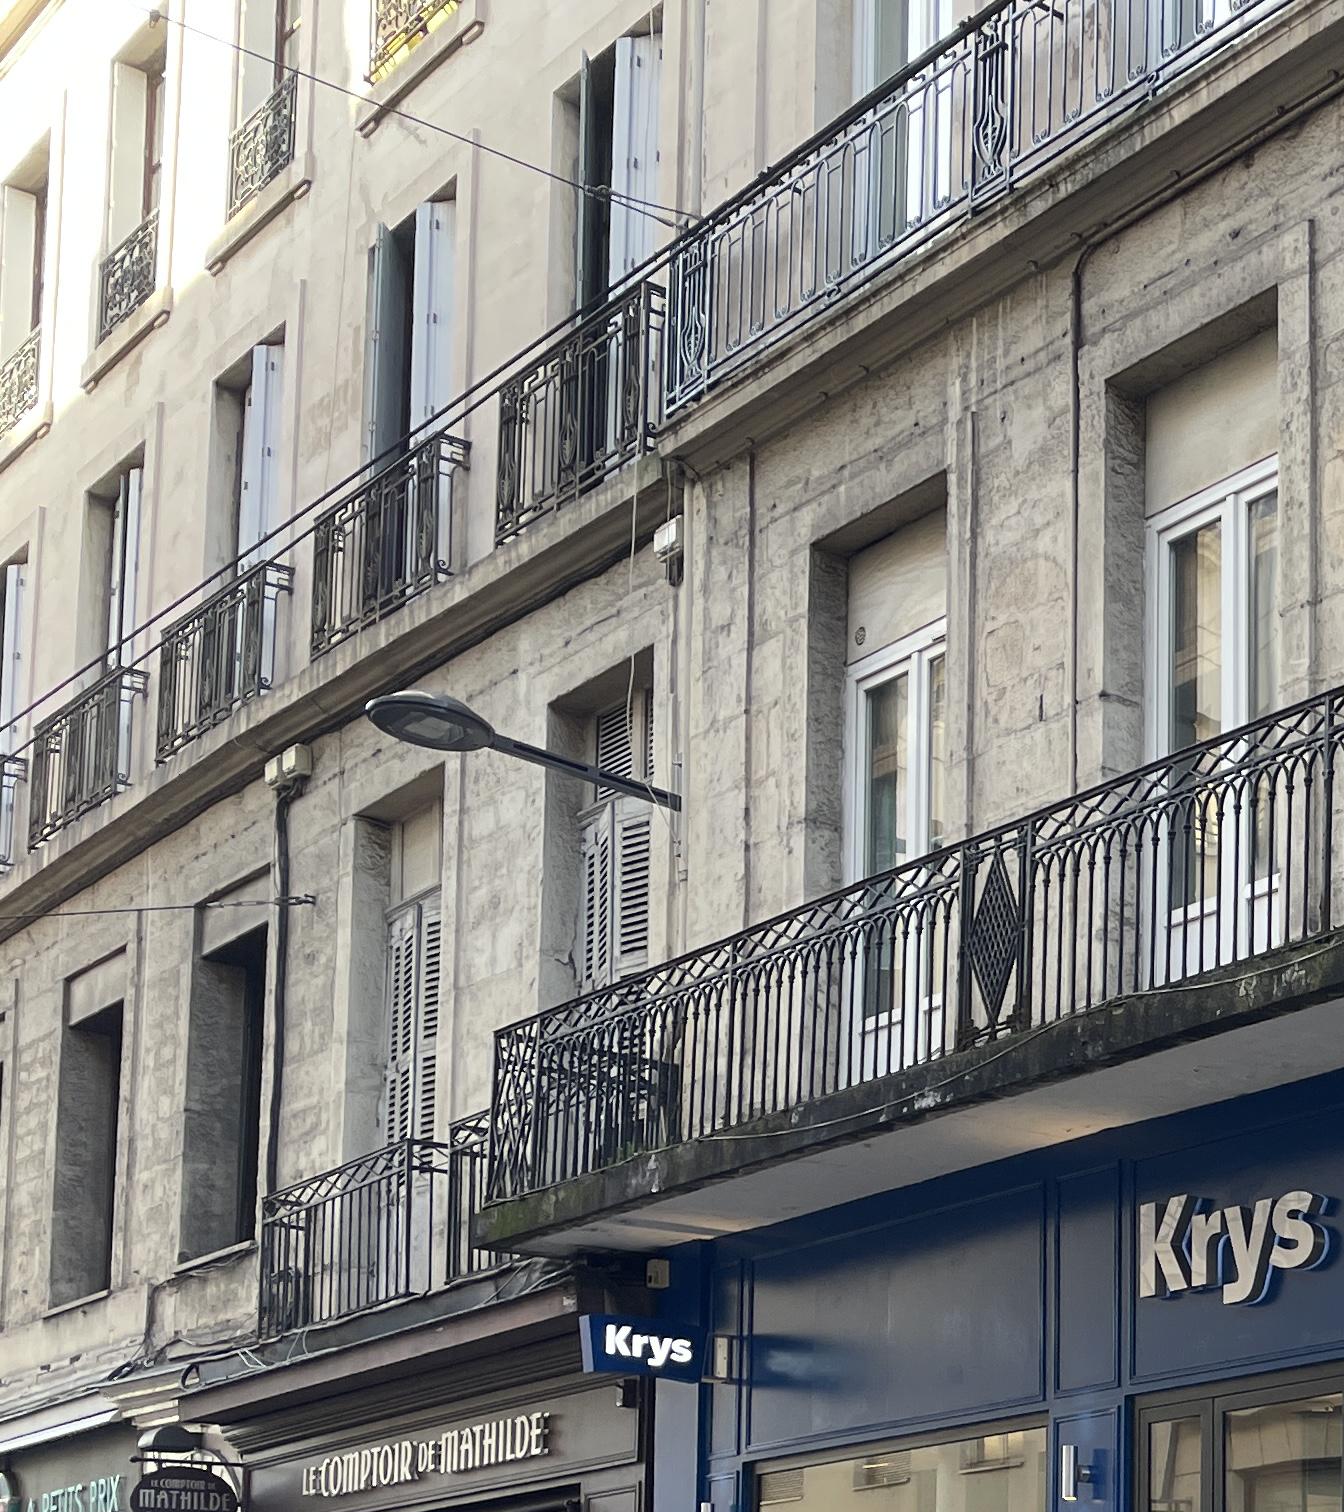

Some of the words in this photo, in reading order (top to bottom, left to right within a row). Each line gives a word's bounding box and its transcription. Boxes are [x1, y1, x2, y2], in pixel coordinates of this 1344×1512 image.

[1139, 1189, 1324, 1305] Krys
[604, 1322, 693, 1367] Krys
[302, 1467, 317, 1496] LE
[319, 1439, 412, 1497] COMPTOIR
[416, 1439, 436, 1473] DE
[440, 1411, 551, 1474] MATHILDE
[139, 1488, 231, 1512] MATHILDE
